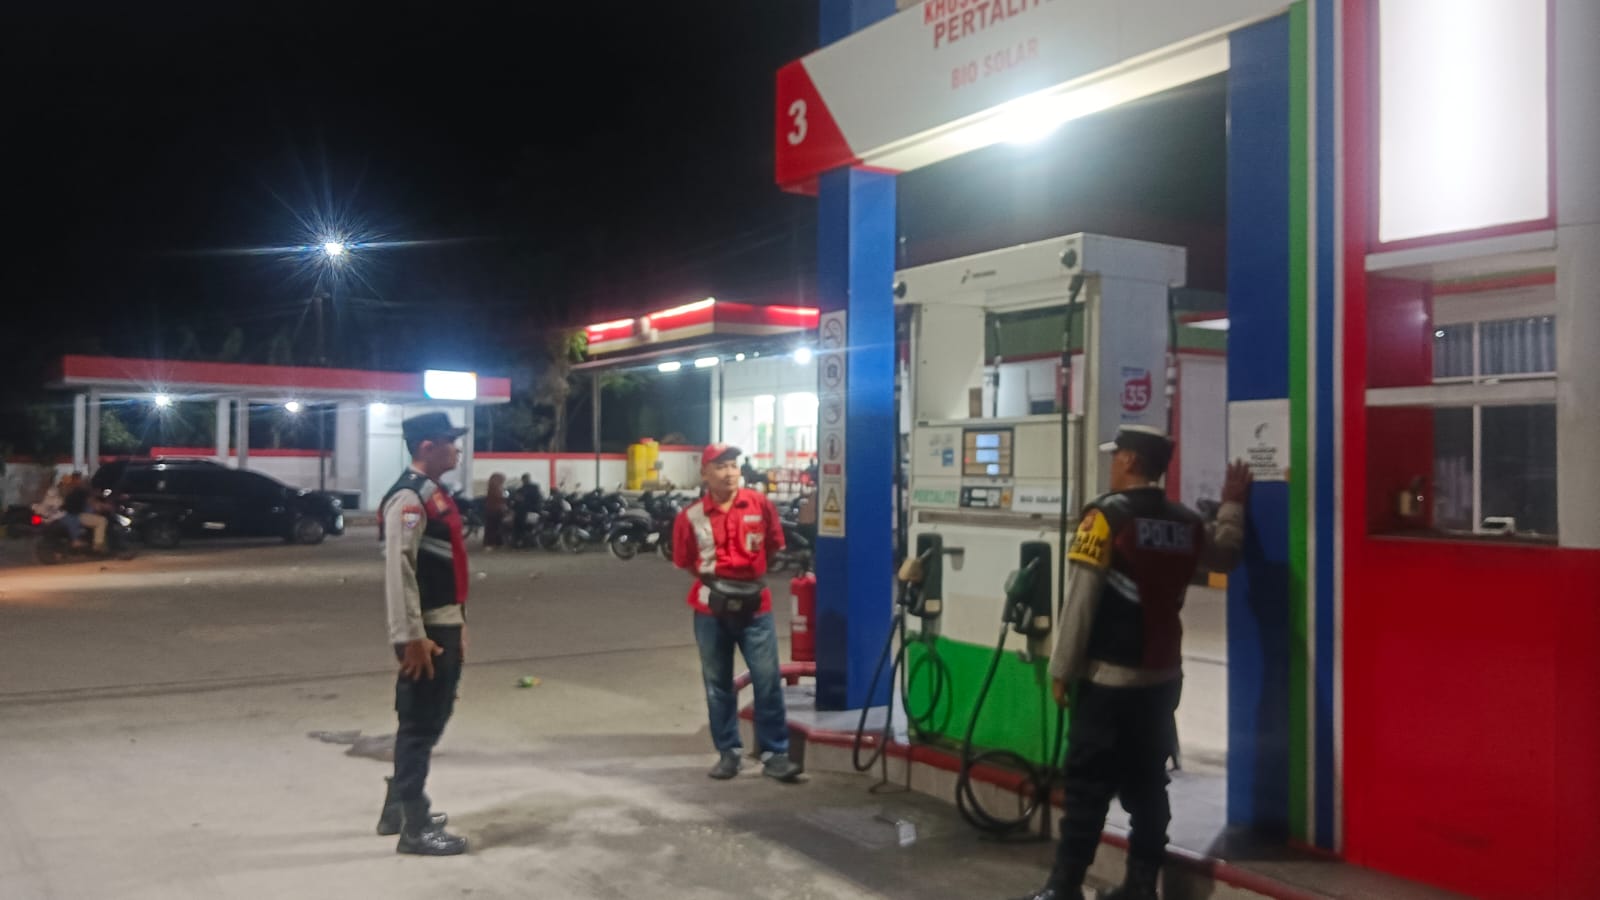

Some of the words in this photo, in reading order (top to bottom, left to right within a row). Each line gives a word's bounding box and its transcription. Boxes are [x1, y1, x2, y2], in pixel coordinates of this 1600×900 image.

[933, 0, 1056, 48] PERTAL
[951, 60, 978, 90] BIO
[984, 37, 1039, 77] SOLAR
[787, 98, 808, 146] 3
